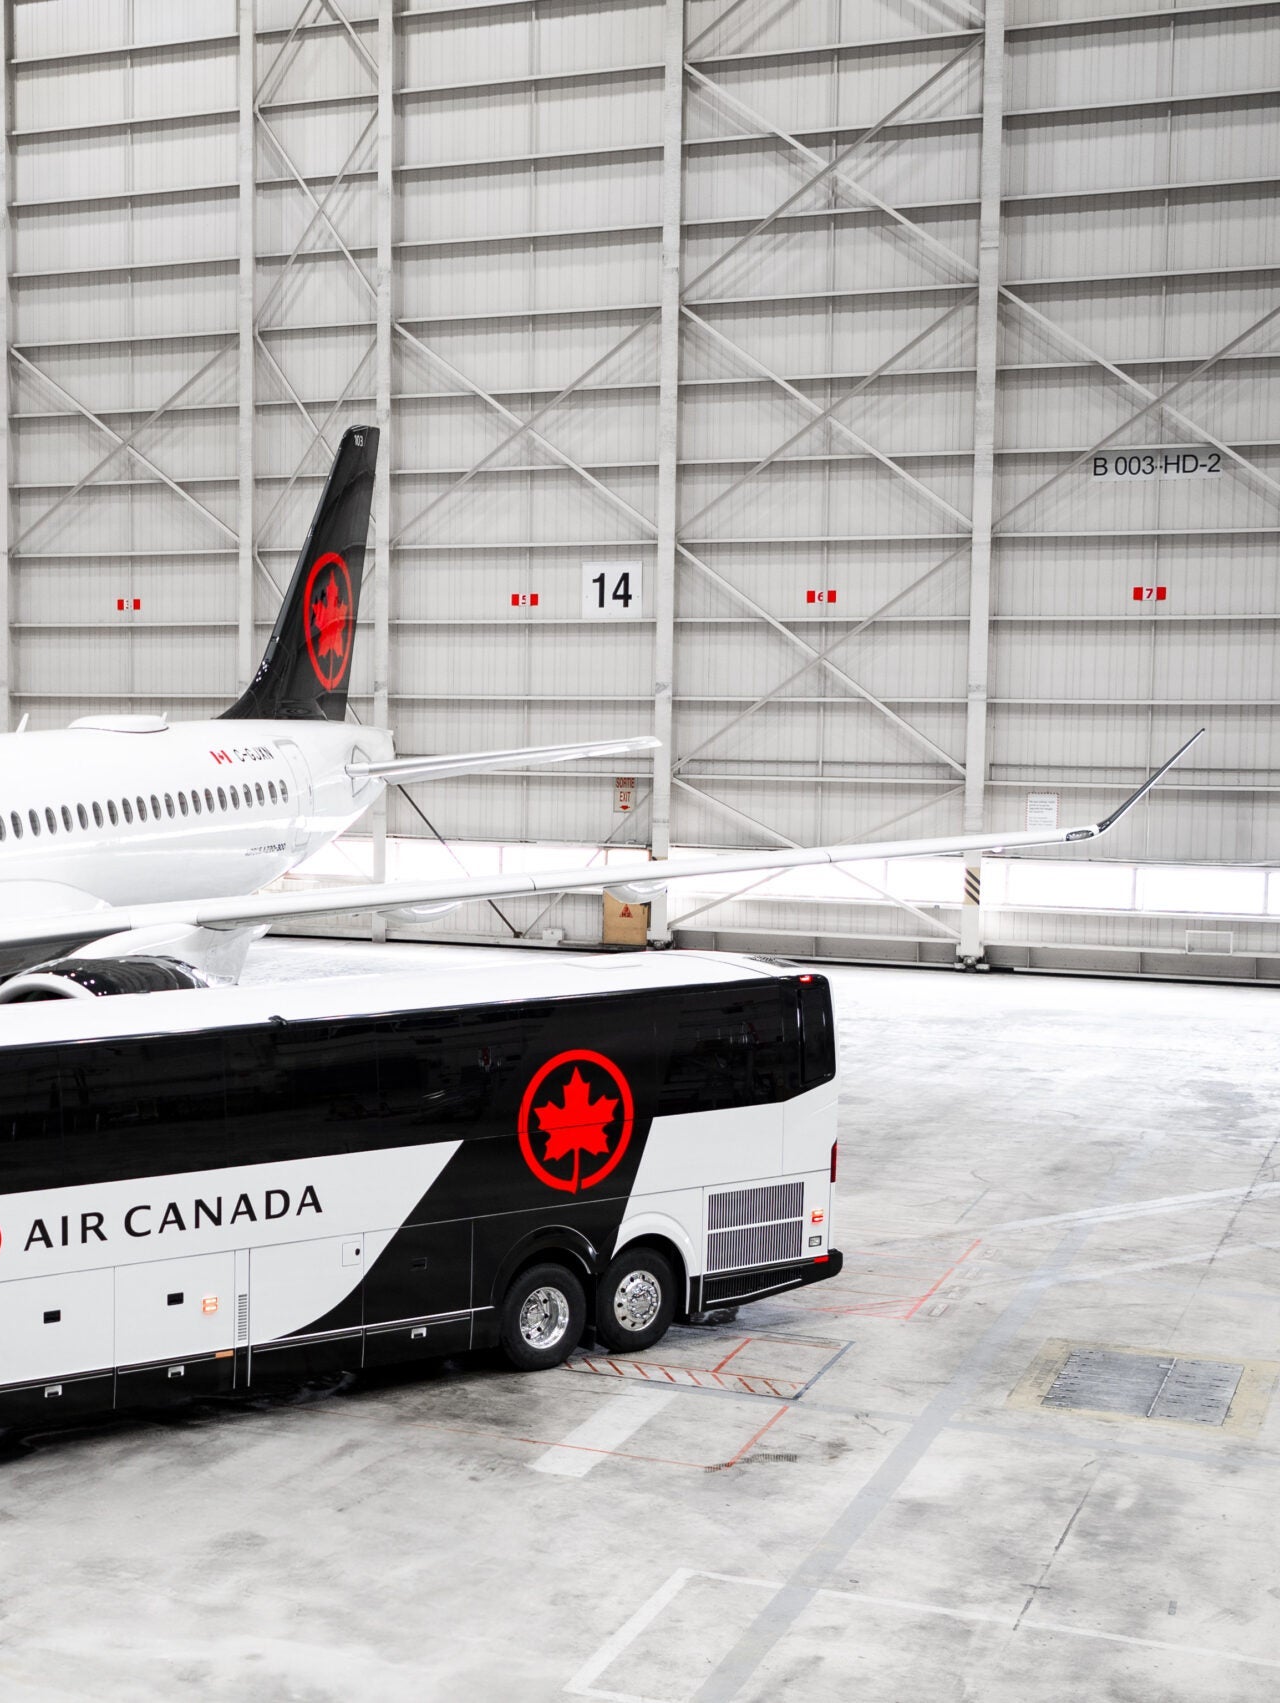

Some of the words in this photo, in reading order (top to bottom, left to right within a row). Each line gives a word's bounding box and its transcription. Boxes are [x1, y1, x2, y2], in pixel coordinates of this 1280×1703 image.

[354, 434, 364, 447] 103
[1093, 457, 1108, 476] B
[592, 572, 632, 608] 14
[1145, 588, 1153, 599] 7
[521, 594, 527, 605] 5
[817, 591, 824, 602] 6
[615, 777, 635, 788] SORTIE
[619, 791, 631, 802] EXIT
[23, 1211, 108, 1252] AIR
[124, 1185, 323, 1238] CANADA
